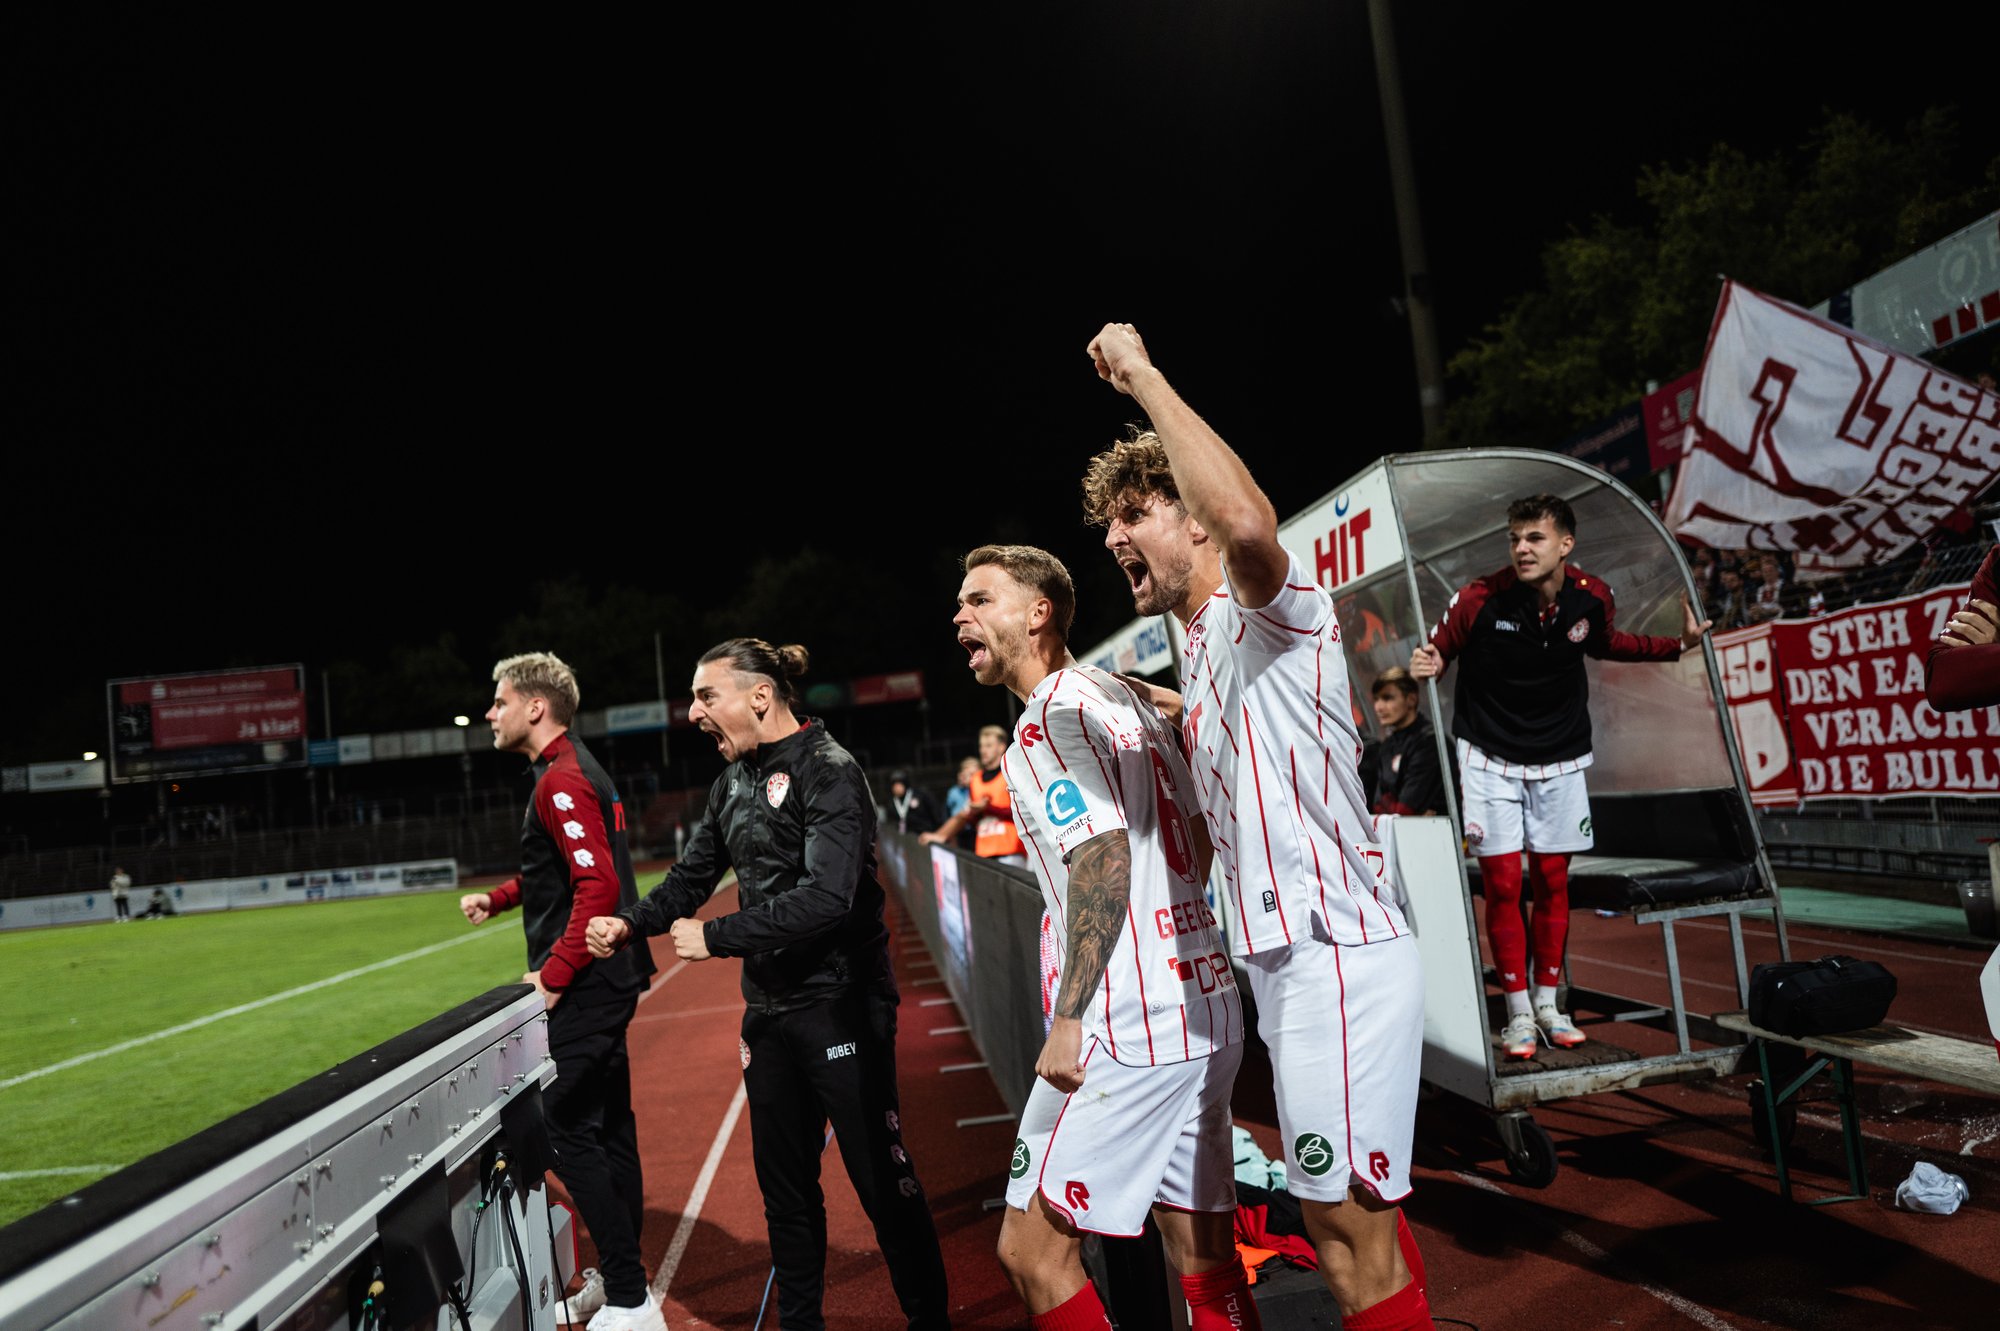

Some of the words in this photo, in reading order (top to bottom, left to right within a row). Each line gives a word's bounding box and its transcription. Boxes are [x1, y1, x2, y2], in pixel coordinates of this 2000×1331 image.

[1314, 507, 1371, 589] HIT
[1808, 607, 1911, 661] STEH
[1924, 596, 1969, 641] Z
[1785, 661, 1862, 705] DEN
[1800, 754, 1873, 793] DIE
[1884, 747, 2000, 791] BULL
[826, 1041, 857, 1061] ROBEY
